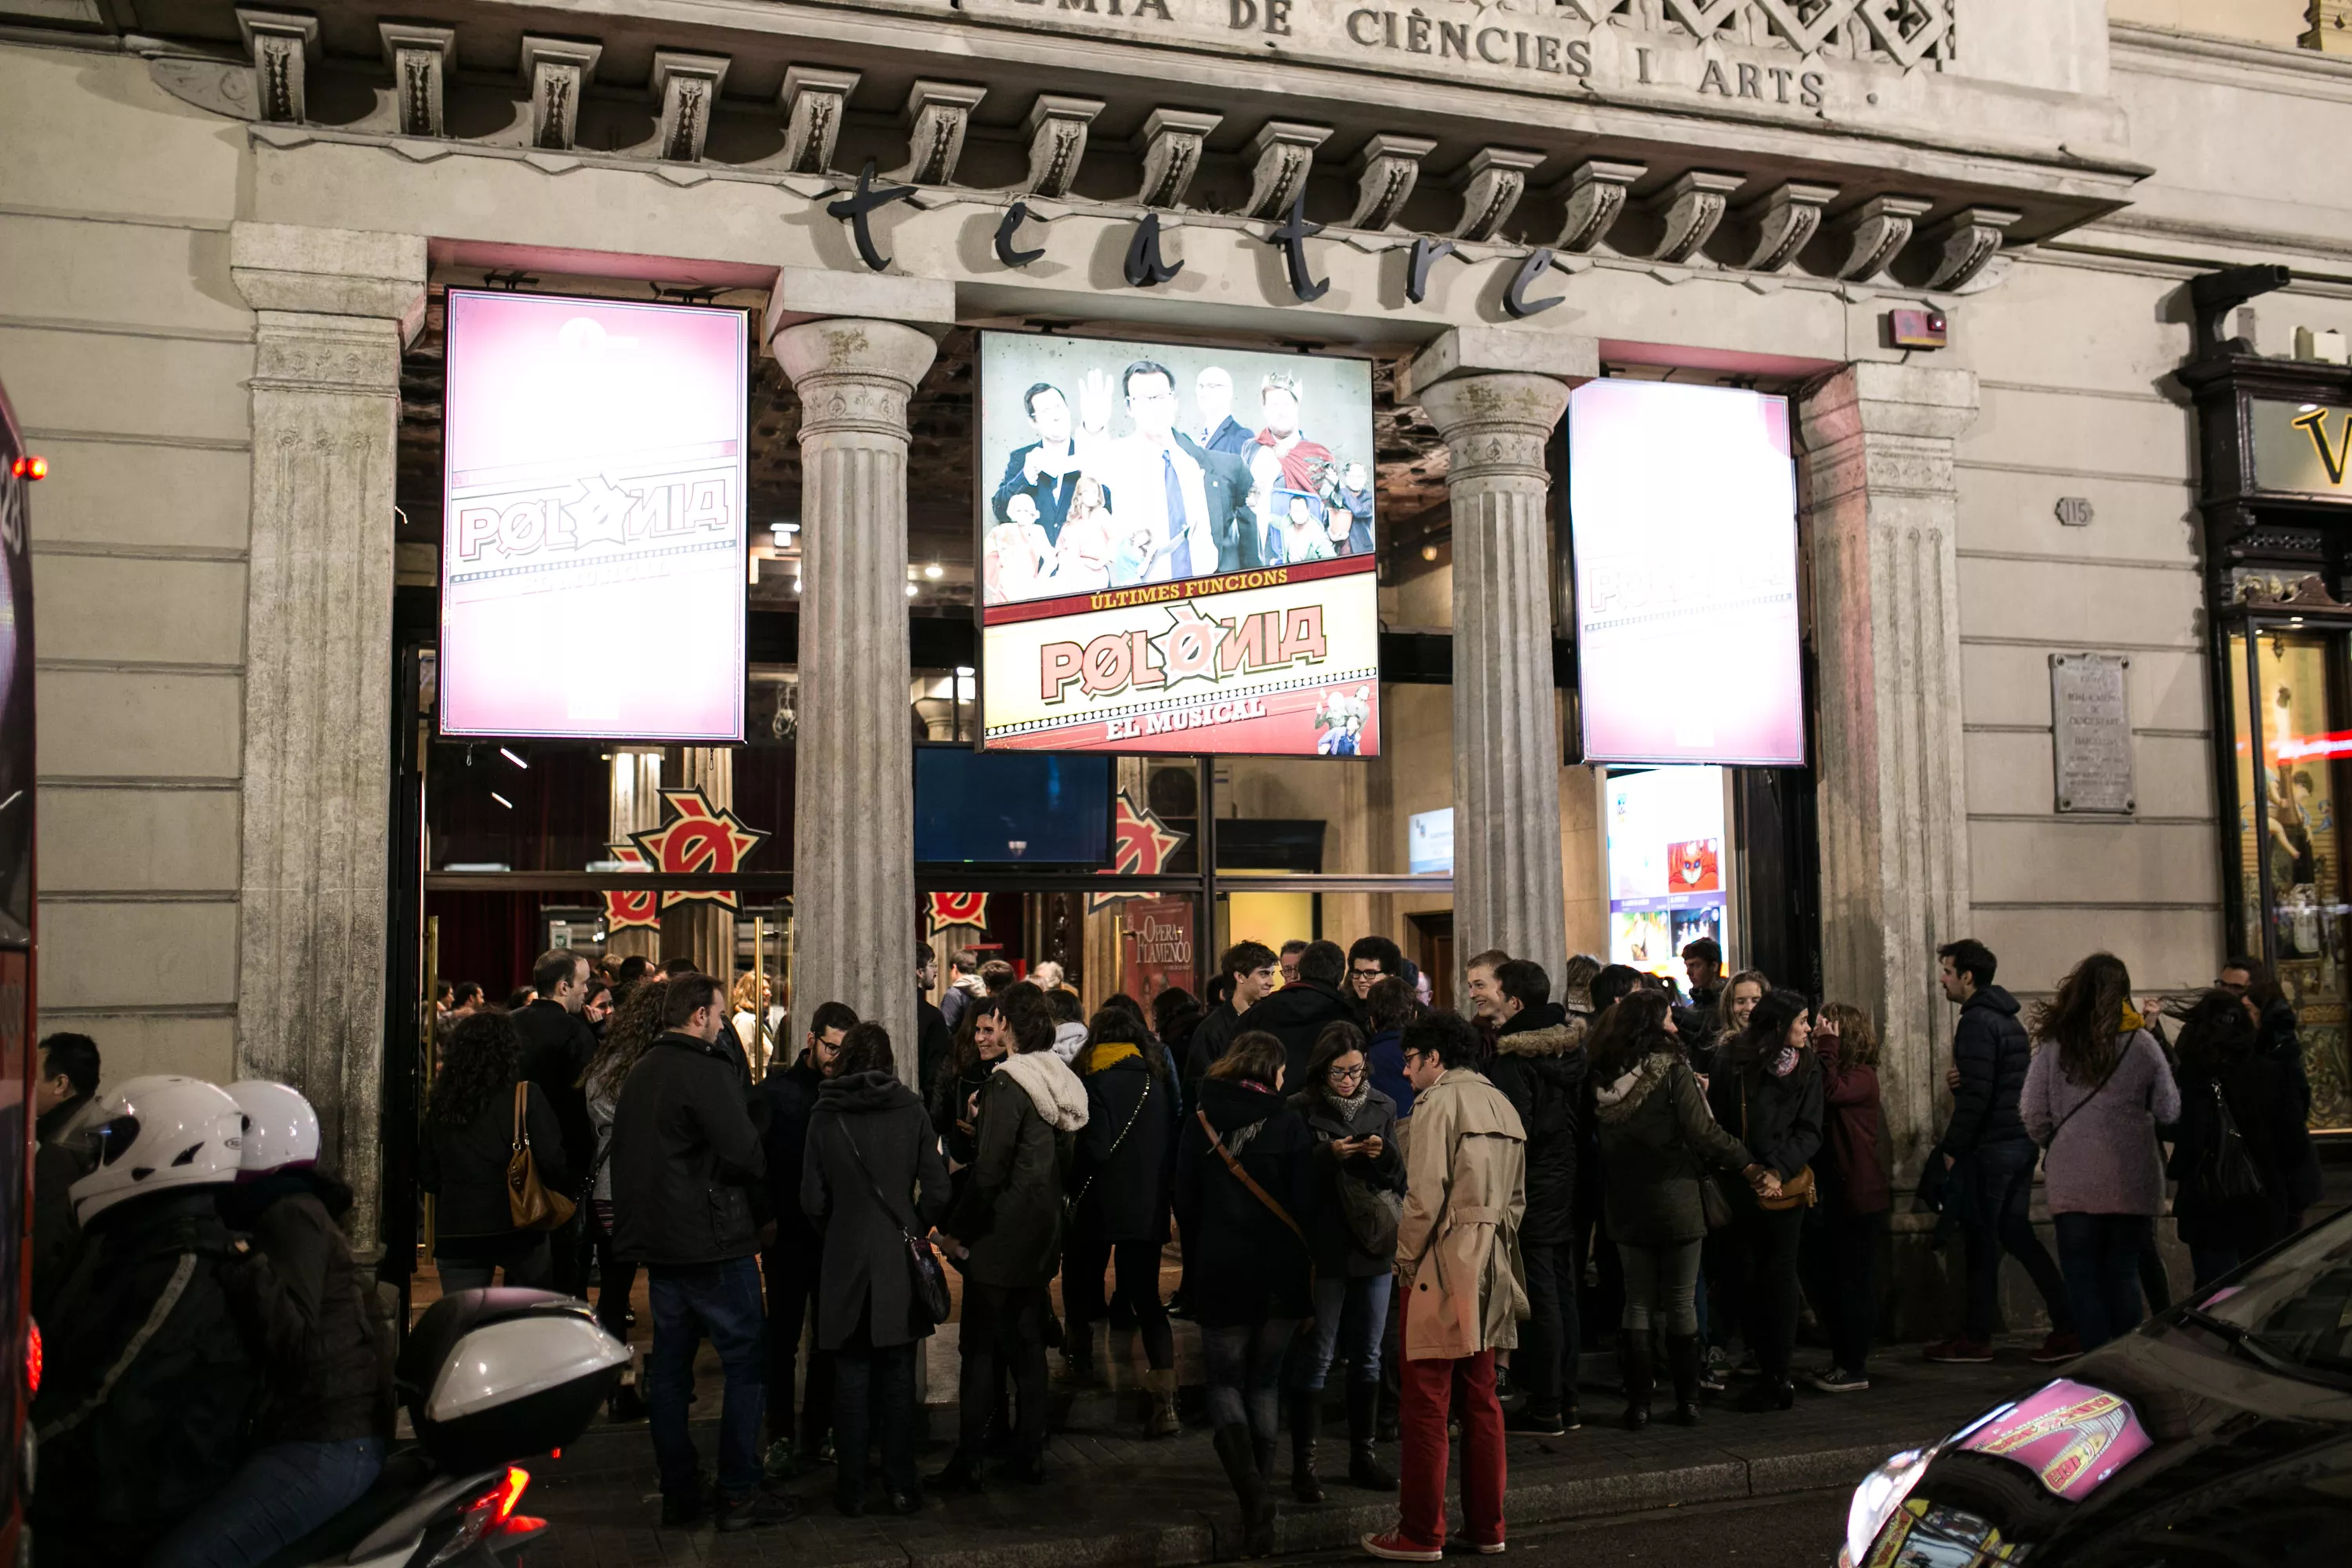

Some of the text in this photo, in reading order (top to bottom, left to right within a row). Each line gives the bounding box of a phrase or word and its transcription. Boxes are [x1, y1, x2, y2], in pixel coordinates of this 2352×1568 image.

[1229, 0, 1824, 108] DE CIÈNCIES I ARTS
[2065, 500, 2088, 524] 115
[1091, 584, 1180, 612] ÚLTIMES
[1185, 569, 1289, 597] FUNCIONS
[1105, 697, 1267, 741] EL MUSICAL
